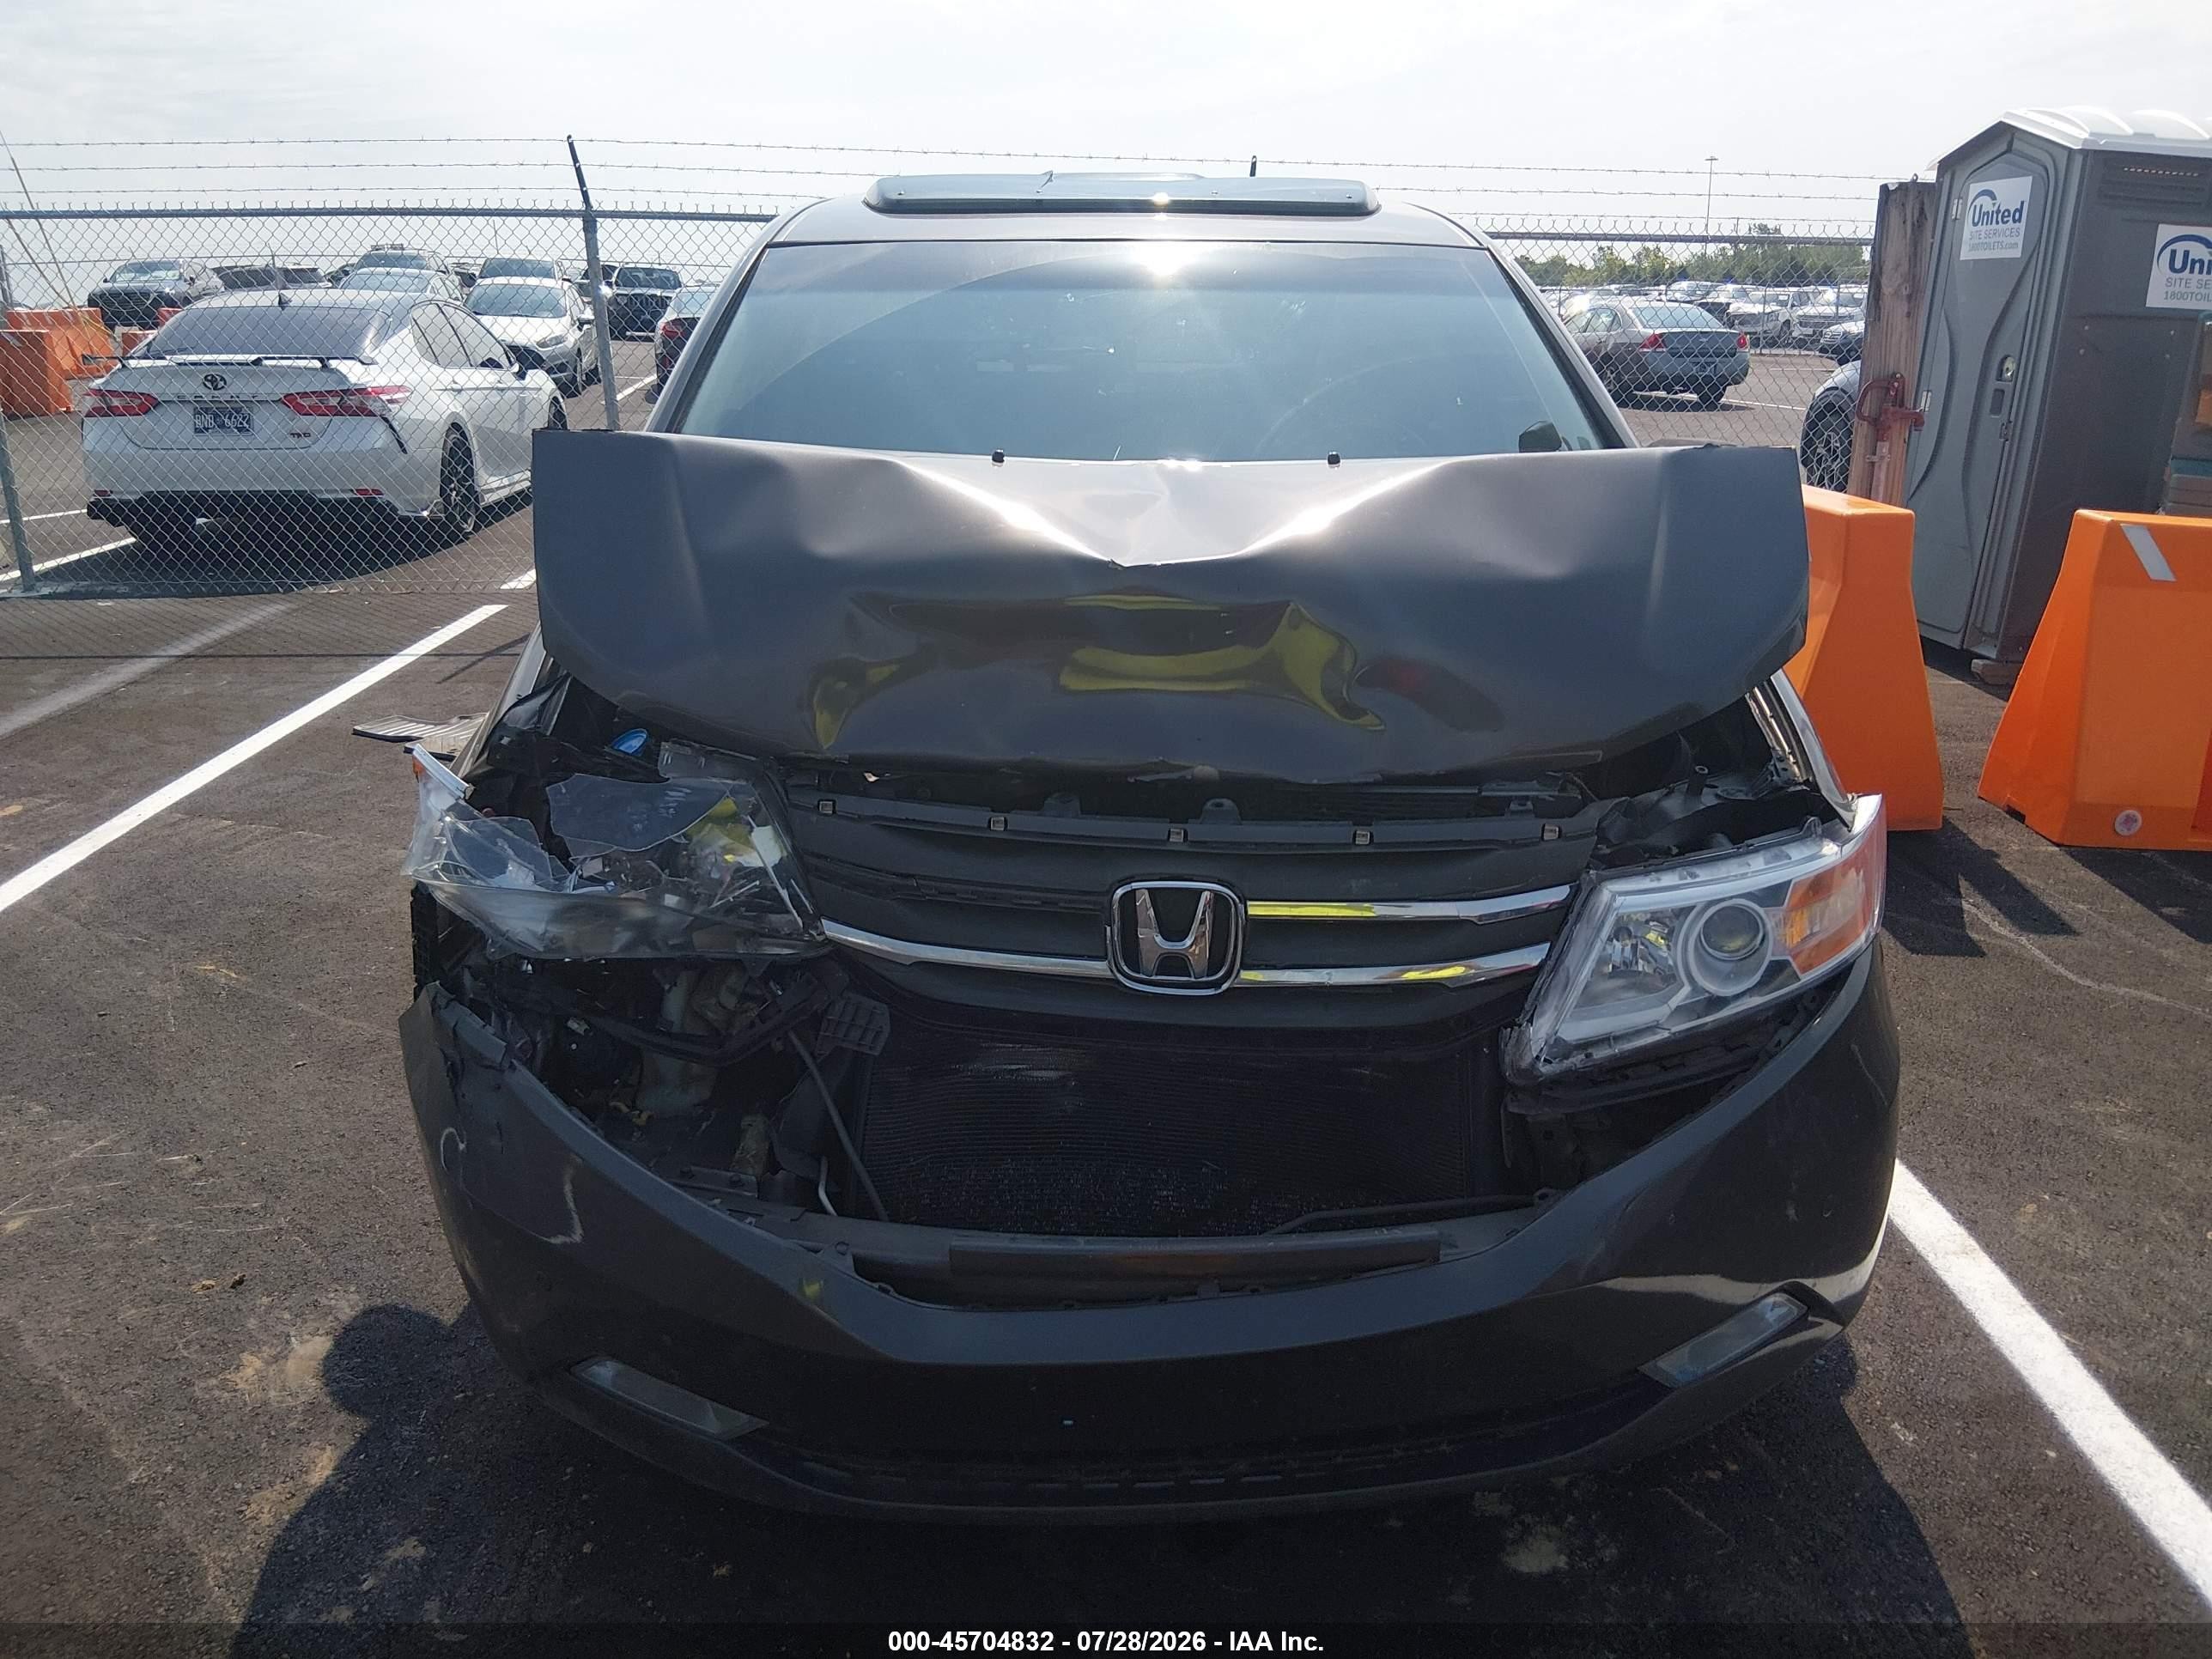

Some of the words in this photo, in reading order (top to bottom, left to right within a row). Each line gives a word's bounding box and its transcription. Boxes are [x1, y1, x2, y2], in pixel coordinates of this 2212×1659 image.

[1972, 200, 2025, 228] United
[1969, 230, 1982, 240] SITE
[1984, 227, 2021, 240] SERVICES
[2165, 277, 2192, 289] SITE
